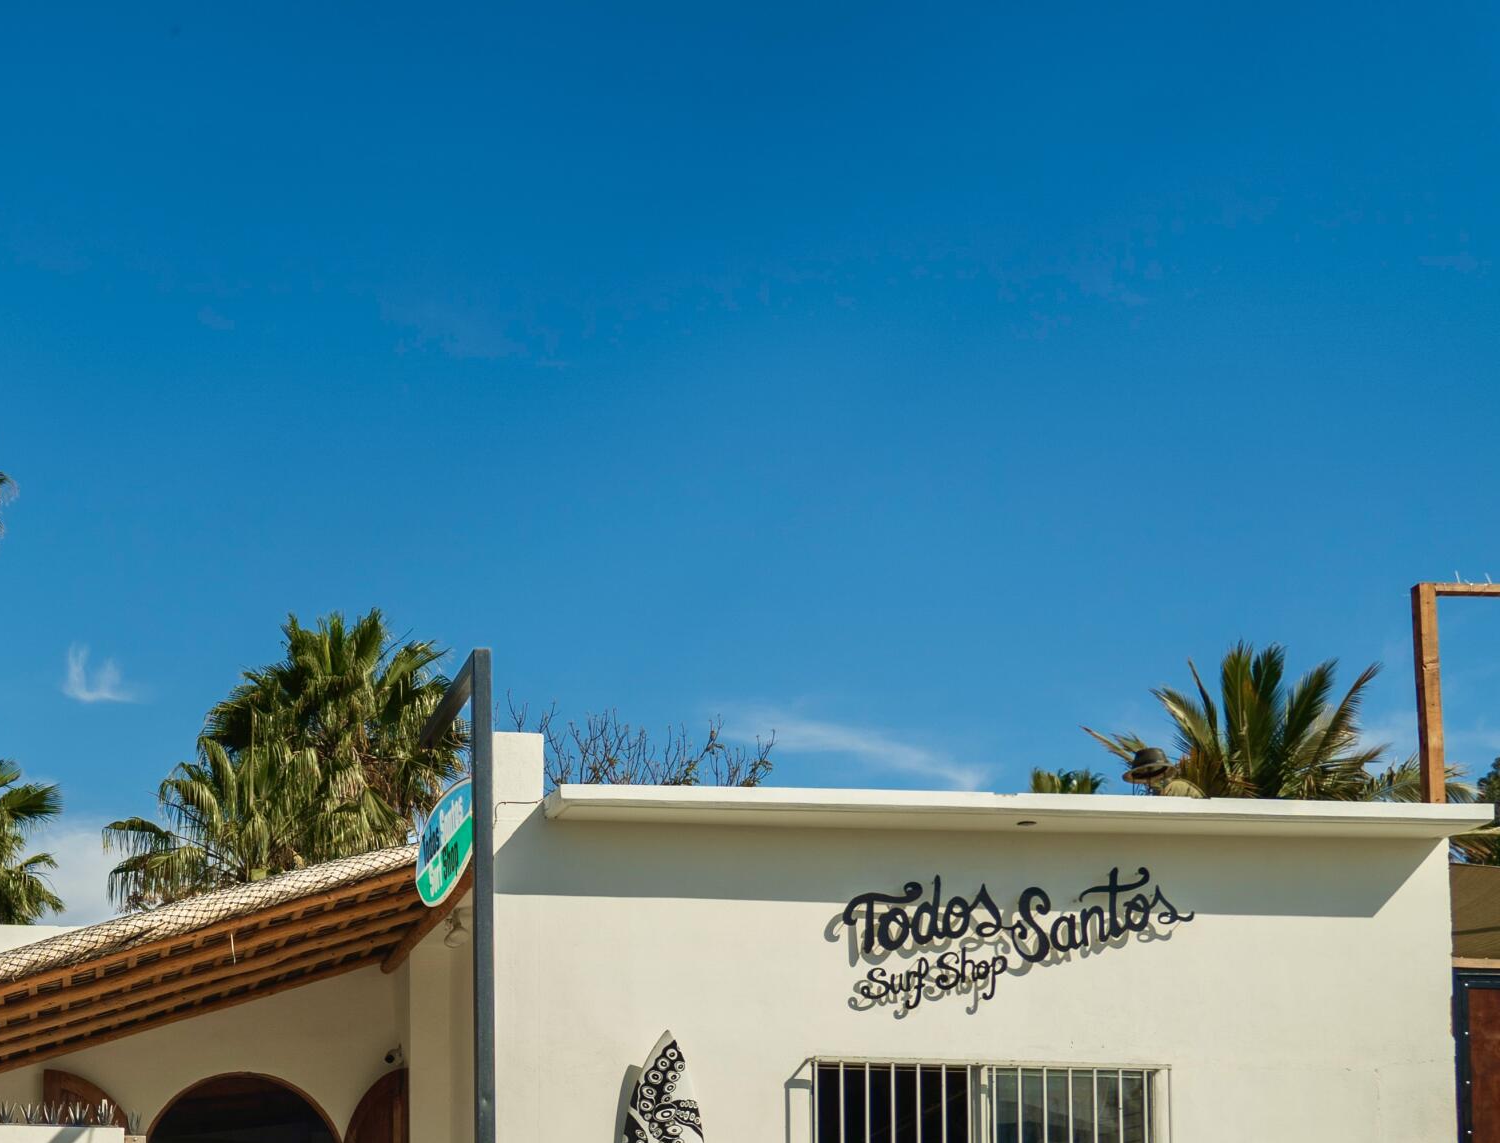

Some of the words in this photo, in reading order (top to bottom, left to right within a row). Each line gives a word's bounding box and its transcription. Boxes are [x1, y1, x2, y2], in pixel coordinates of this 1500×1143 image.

[441, 841, 459, 880] Shop
[843, 874, 1002, 954] Todos
[1008, 867, 1194, 962] Santos
[861, 957, 929, 1010] Surf
[936, 947, 1007, 1000] Shop
